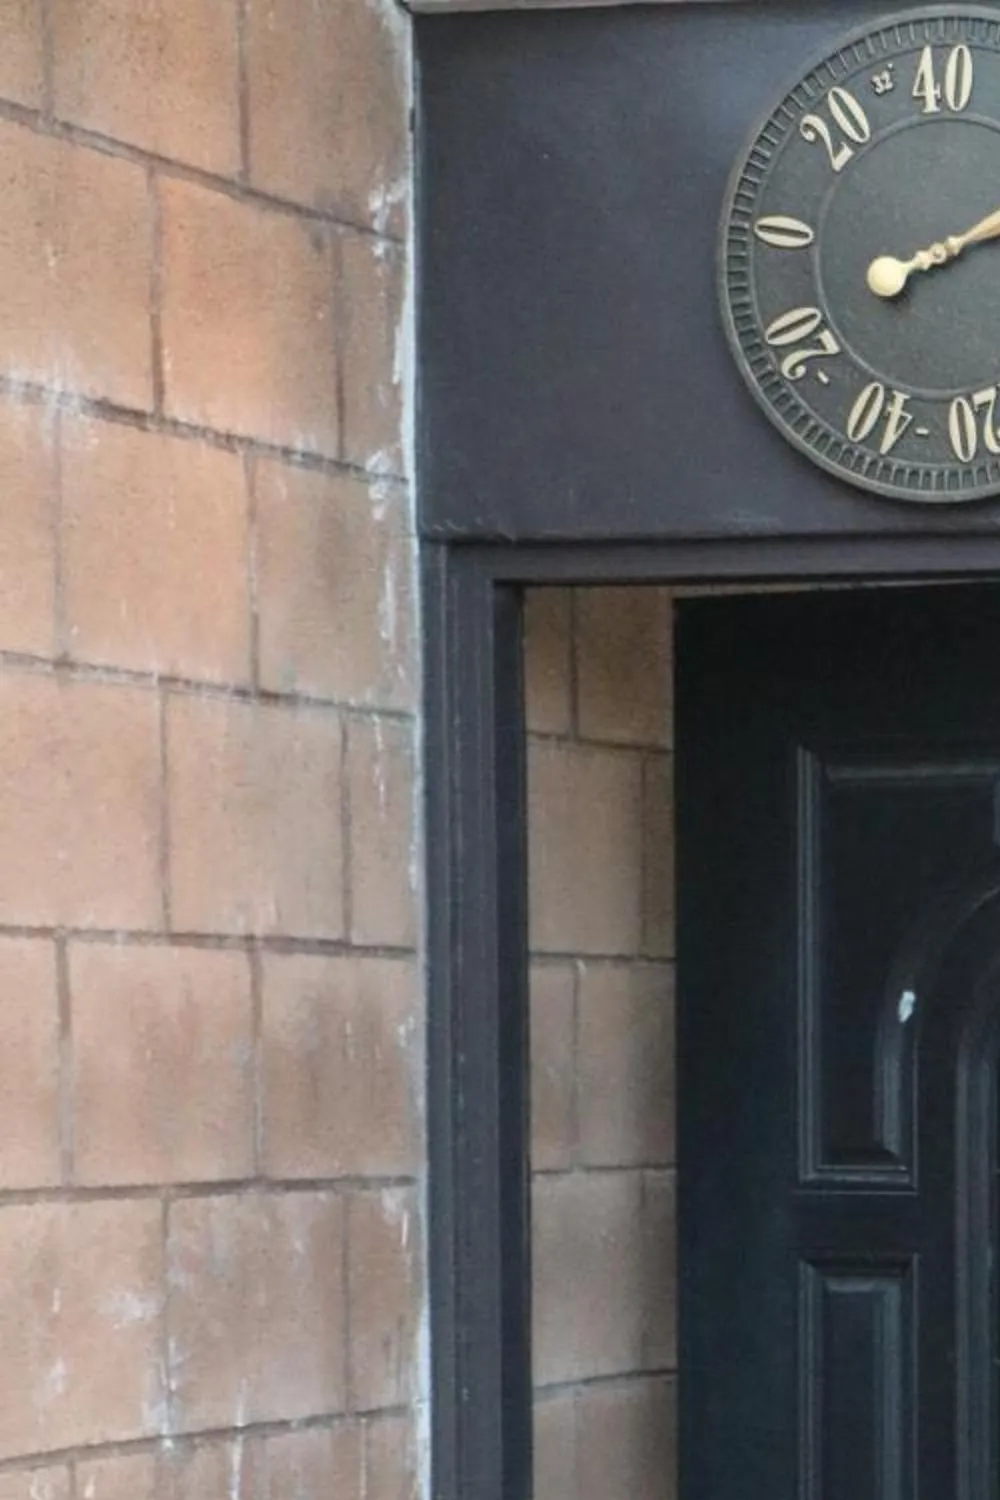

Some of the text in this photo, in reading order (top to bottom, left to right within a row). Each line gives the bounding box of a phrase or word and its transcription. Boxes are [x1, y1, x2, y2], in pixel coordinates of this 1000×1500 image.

[912, 44, 973, 113] 40
[801, 86, 870, 171] 20
[754, 215, 814, 247] 0
